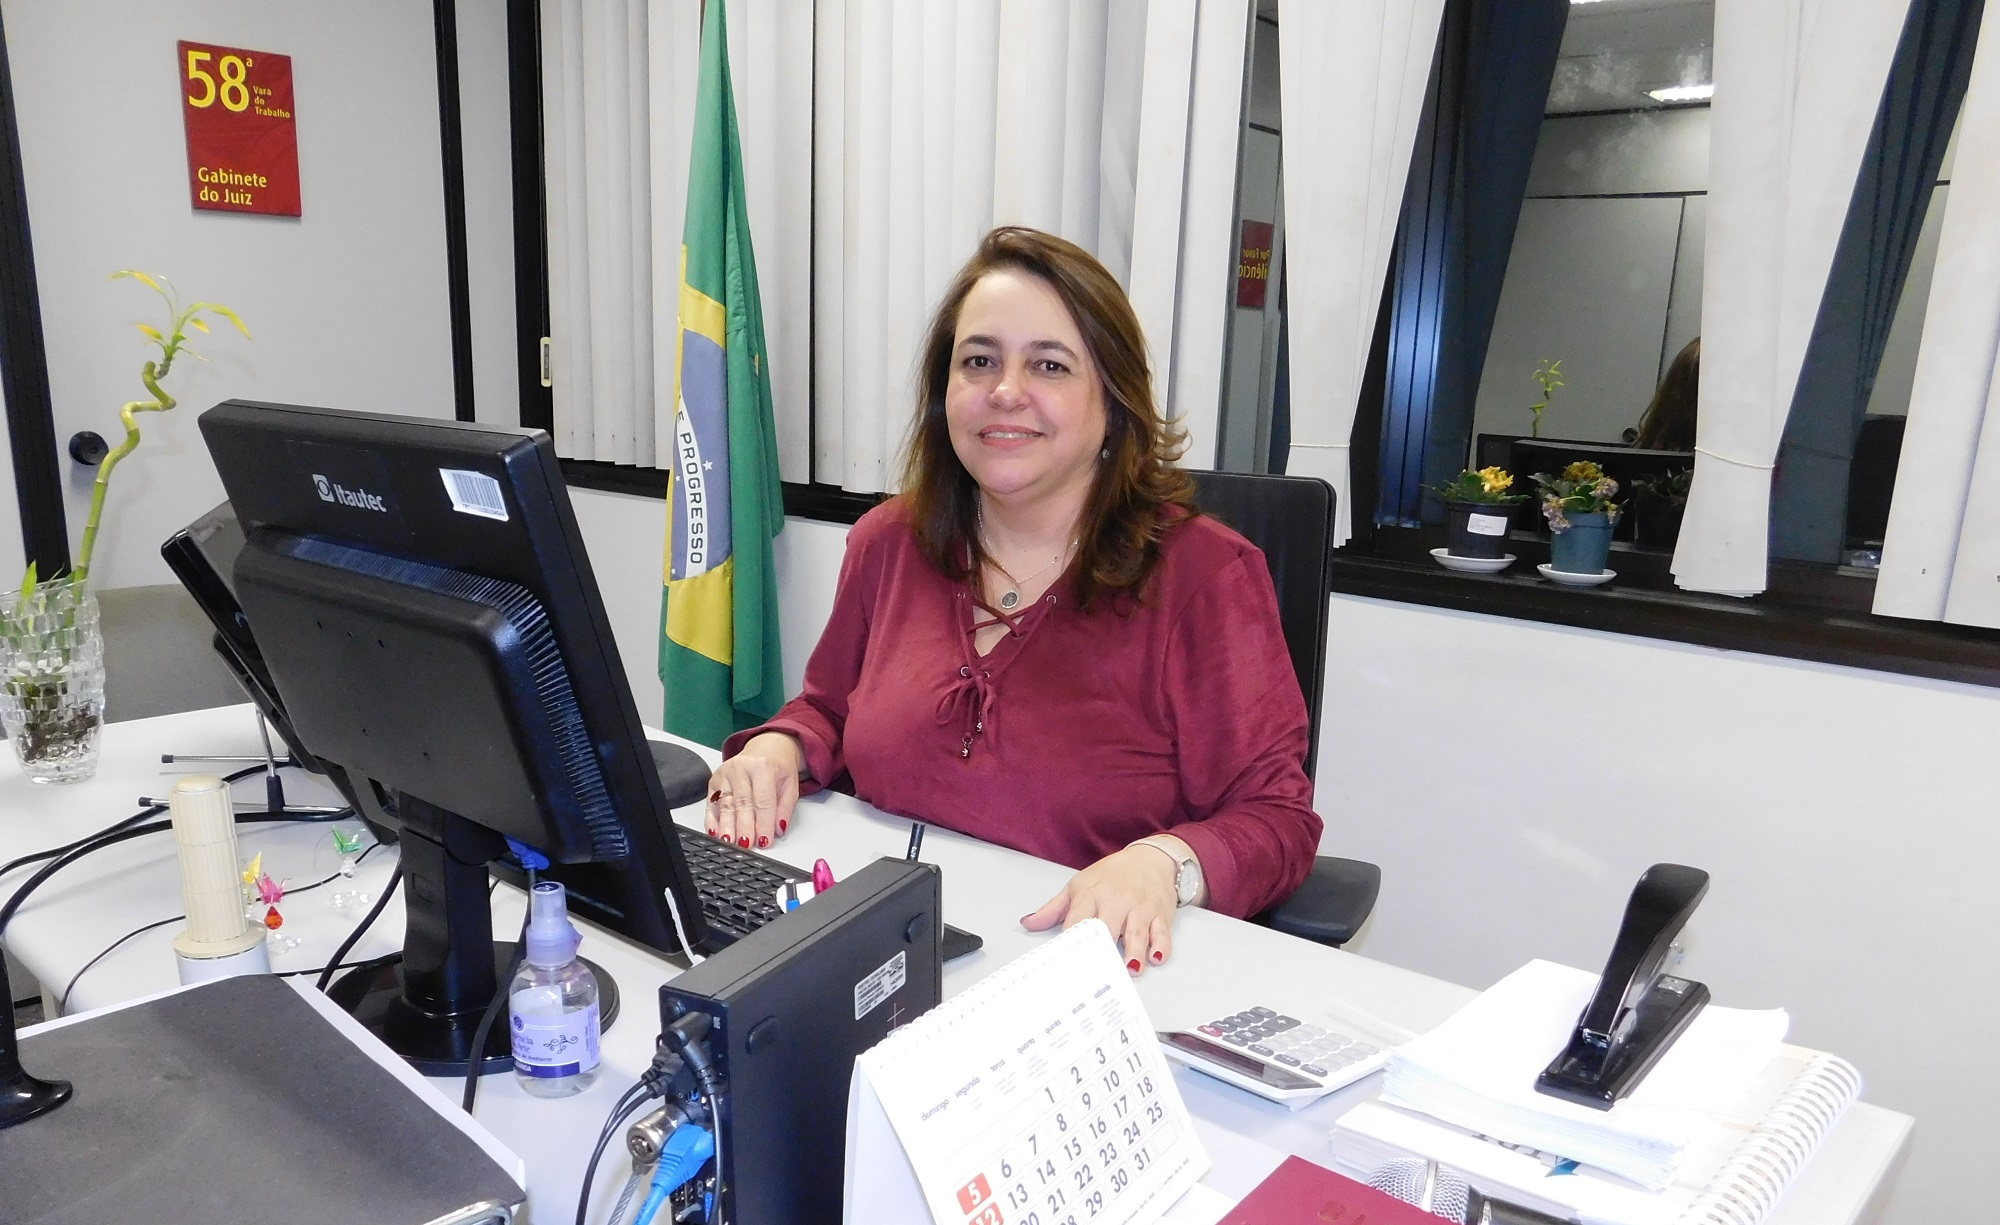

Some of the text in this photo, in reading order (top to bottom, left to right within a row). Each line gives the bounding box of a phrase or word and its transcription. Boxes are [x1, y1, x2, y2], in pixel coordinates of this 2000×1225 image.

[253, 85, 272, 96] Vara
[254, 96, 265, 106] do
[254, 106, 291, 119] Trabalho
[198, 167, 267, 188] Gabinete
[200, 186, 219, 202] do
[224, 188, 253, 205] Juiz
[333, 483, 387, 513] Itautec
[680, 432, 704, 564] PROGRESSO
[921, 1098, 950, 1121] domingo
[954, 1076, 981, 1098] segunda
[1016, 1037, 1036, 1055] quarta
[1044, 1019, 1062, 1035] quinta
[1071, 1002, 1086, 1015] sexta
[1044, 1086, 1055, 1104] 1
[1070, 1065, 1083, 1085] 2
[1095, 1046, 1106, 1065] 3
[1120, 1029, 1129, 1045] 4
[968, 1051, 1142, 1206] 5 6 7 8 9 10 11
[1007, 1183, 1029, 1210] 13
[1036, 1159, 1057, 1185] 14
[1064, 1136, 1082, 1162] 15
[1088, 1115, 1107, 1140] 16
[1113, 1094, 1128, 1119] 17
[1136, 1076, 1153, 1099] 18
[1020, 1100, 1163, 1225] 0 21 22 23 24 25
[1085, 1190, 1103, 1218] 29
[1110, 1167, 1129, 1194] 30
[1134, 1147, 1151, 1171] 31
